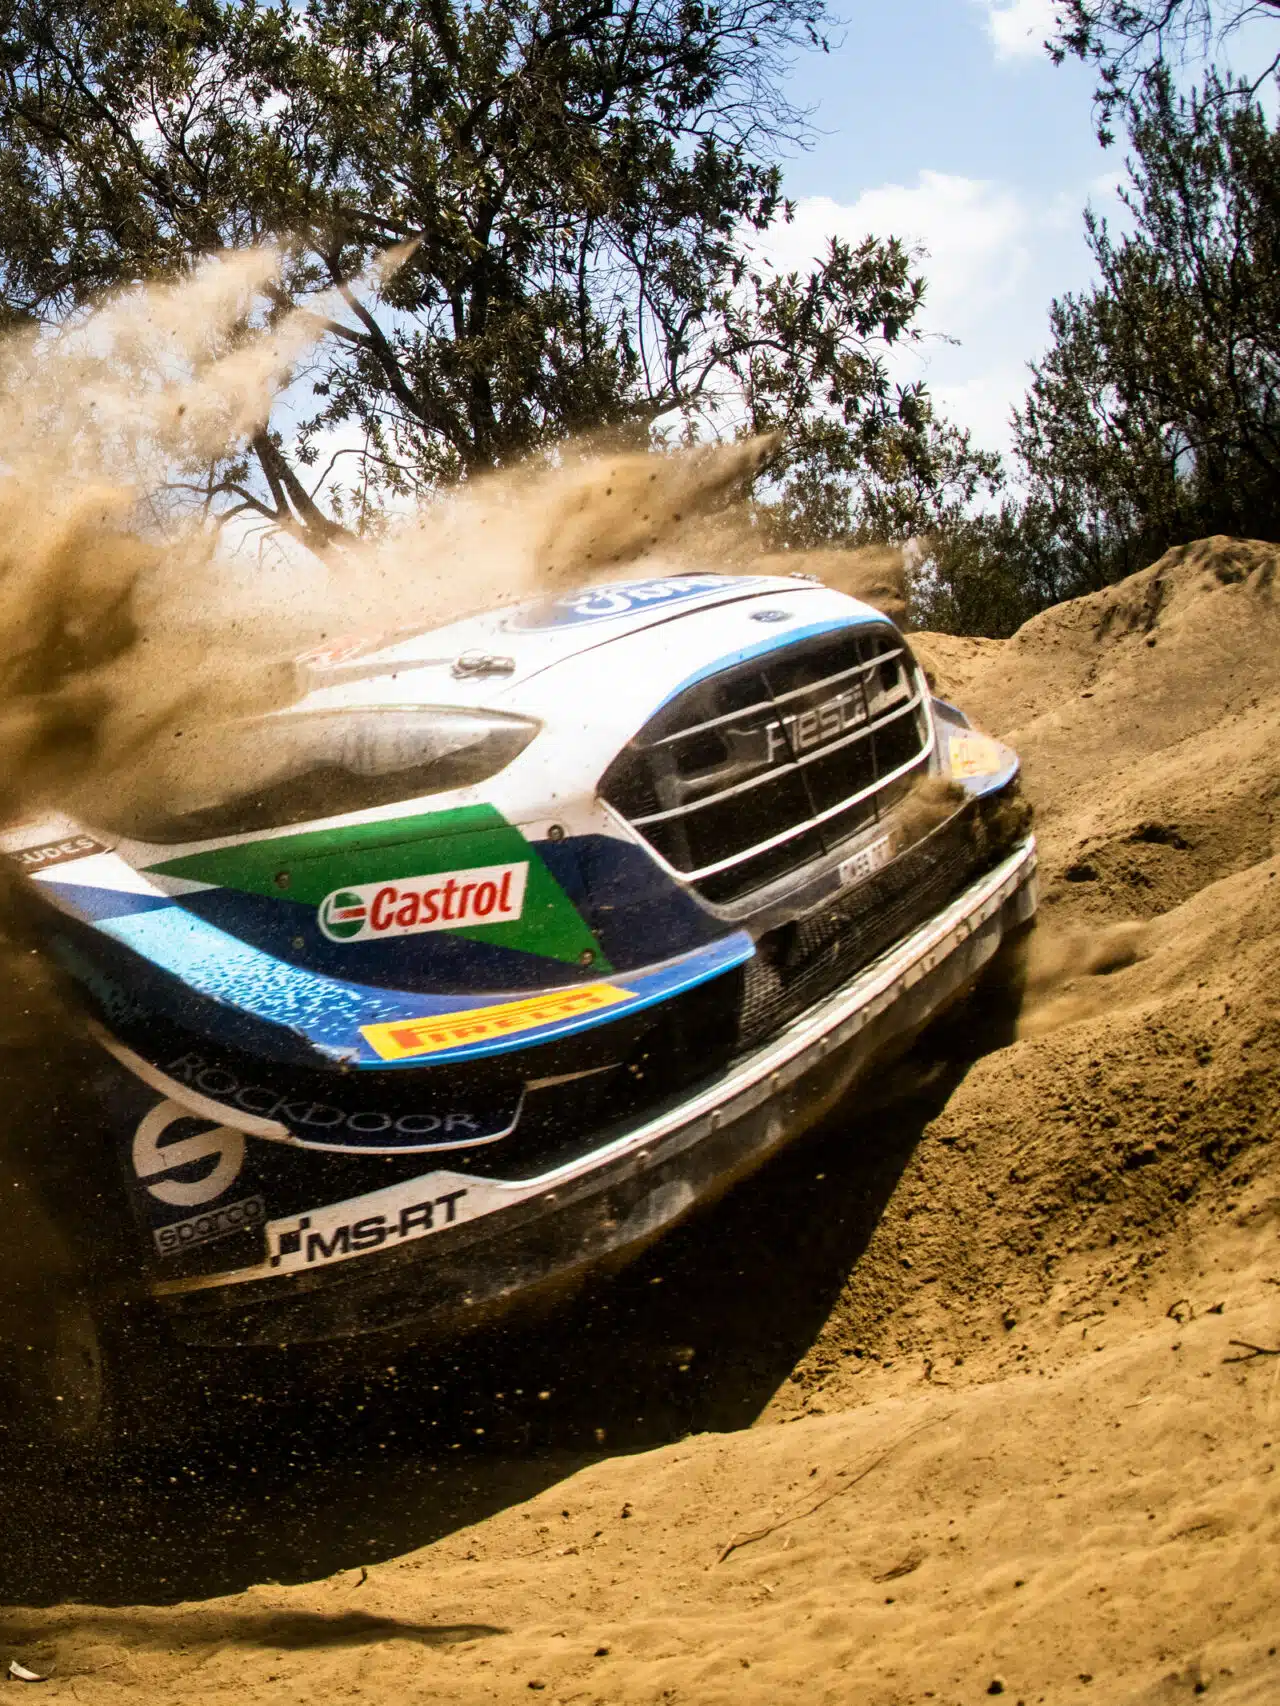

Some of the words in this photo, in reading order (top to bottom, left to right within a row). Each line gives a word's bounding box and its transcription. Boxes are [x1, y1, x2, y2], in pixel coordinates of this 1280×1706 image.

[370, 871, 513, 931] Castrol
[388, 992, 604, 1049] PIRELLI
[168, 1052, 478, 1133] ROCKDOOR
[158, 1200, 262, 1249] sparco
[307, 1189, 467, 1262] MS-RT
